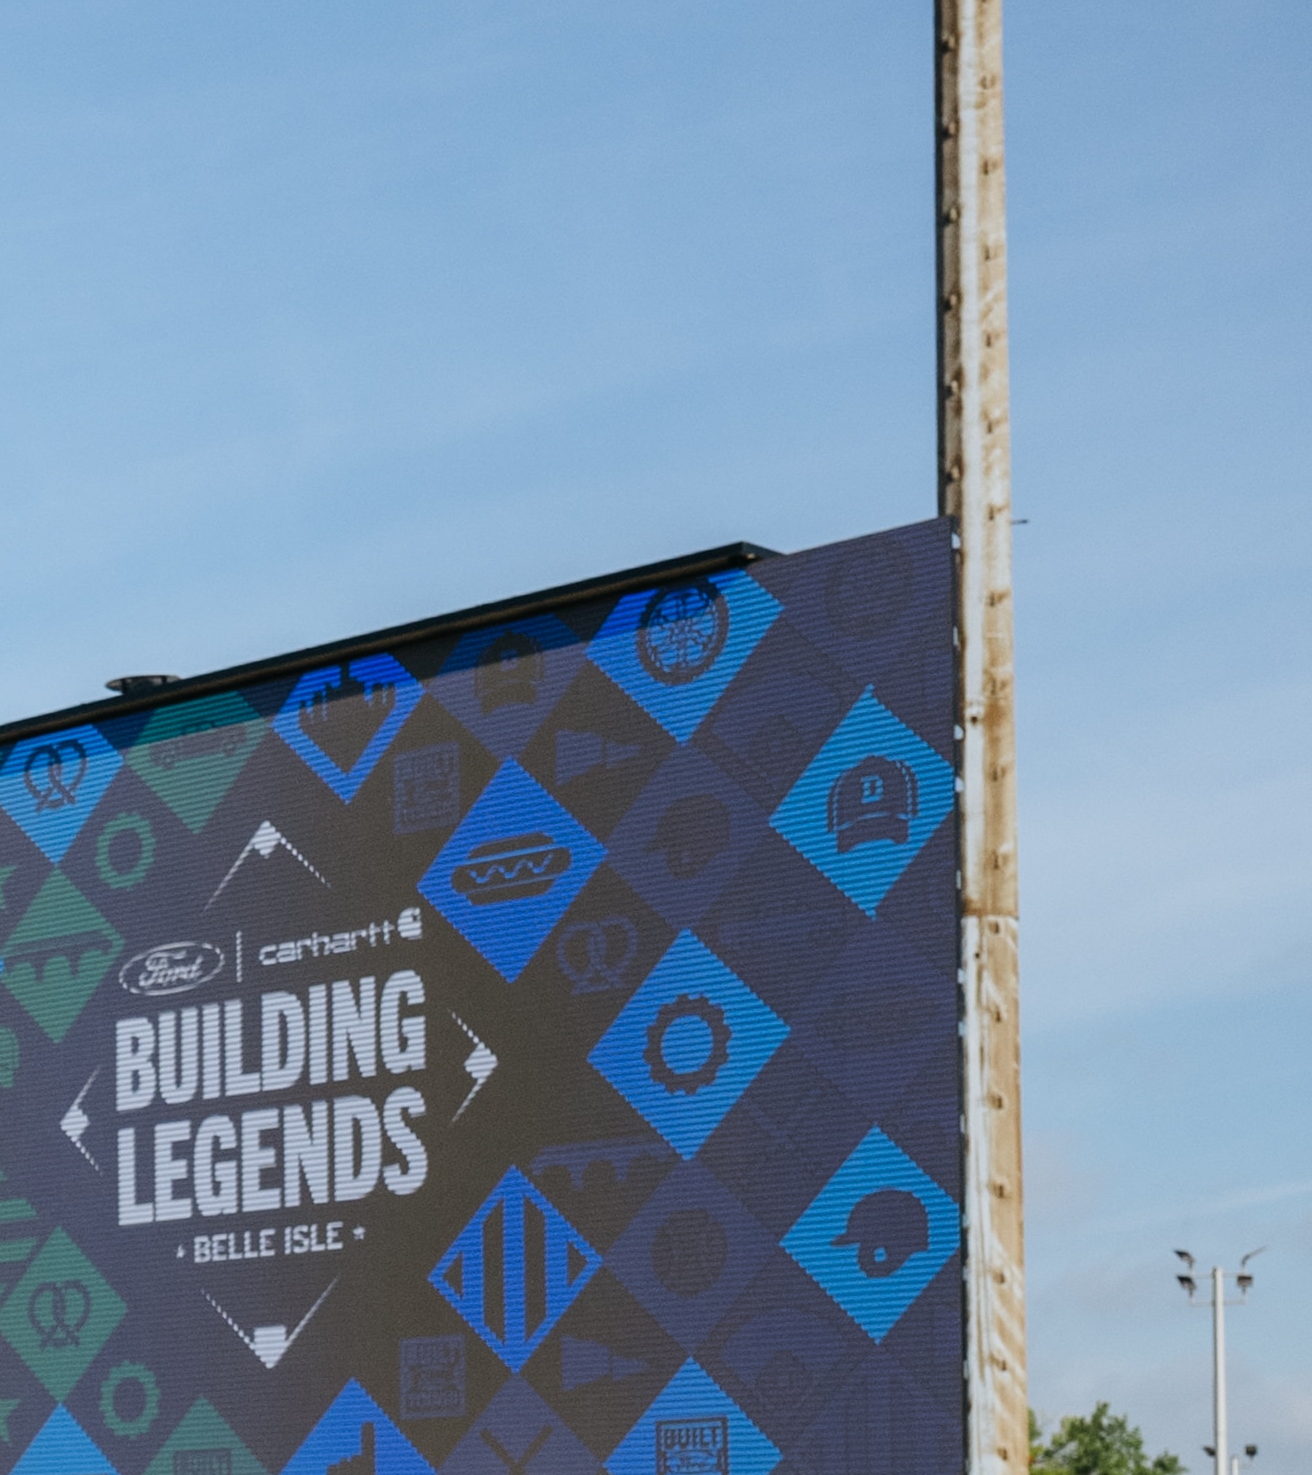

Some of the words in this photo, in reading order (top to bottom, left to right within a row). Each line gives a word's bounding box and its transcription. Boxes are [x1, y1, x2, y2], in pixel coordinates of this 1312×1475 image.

[138, 950, 204, 987] Ford
[258, 920, 395, 966] carhartt
[115, 969, 427, 1112] BUILDING
[117, 1086, 428, 1226] LEGENDS
[193, 1228, 276, 1264] BELLE
[283, 1221, 344, 1256] ISLE
[663, 1426, 721, 1449] BUILT
